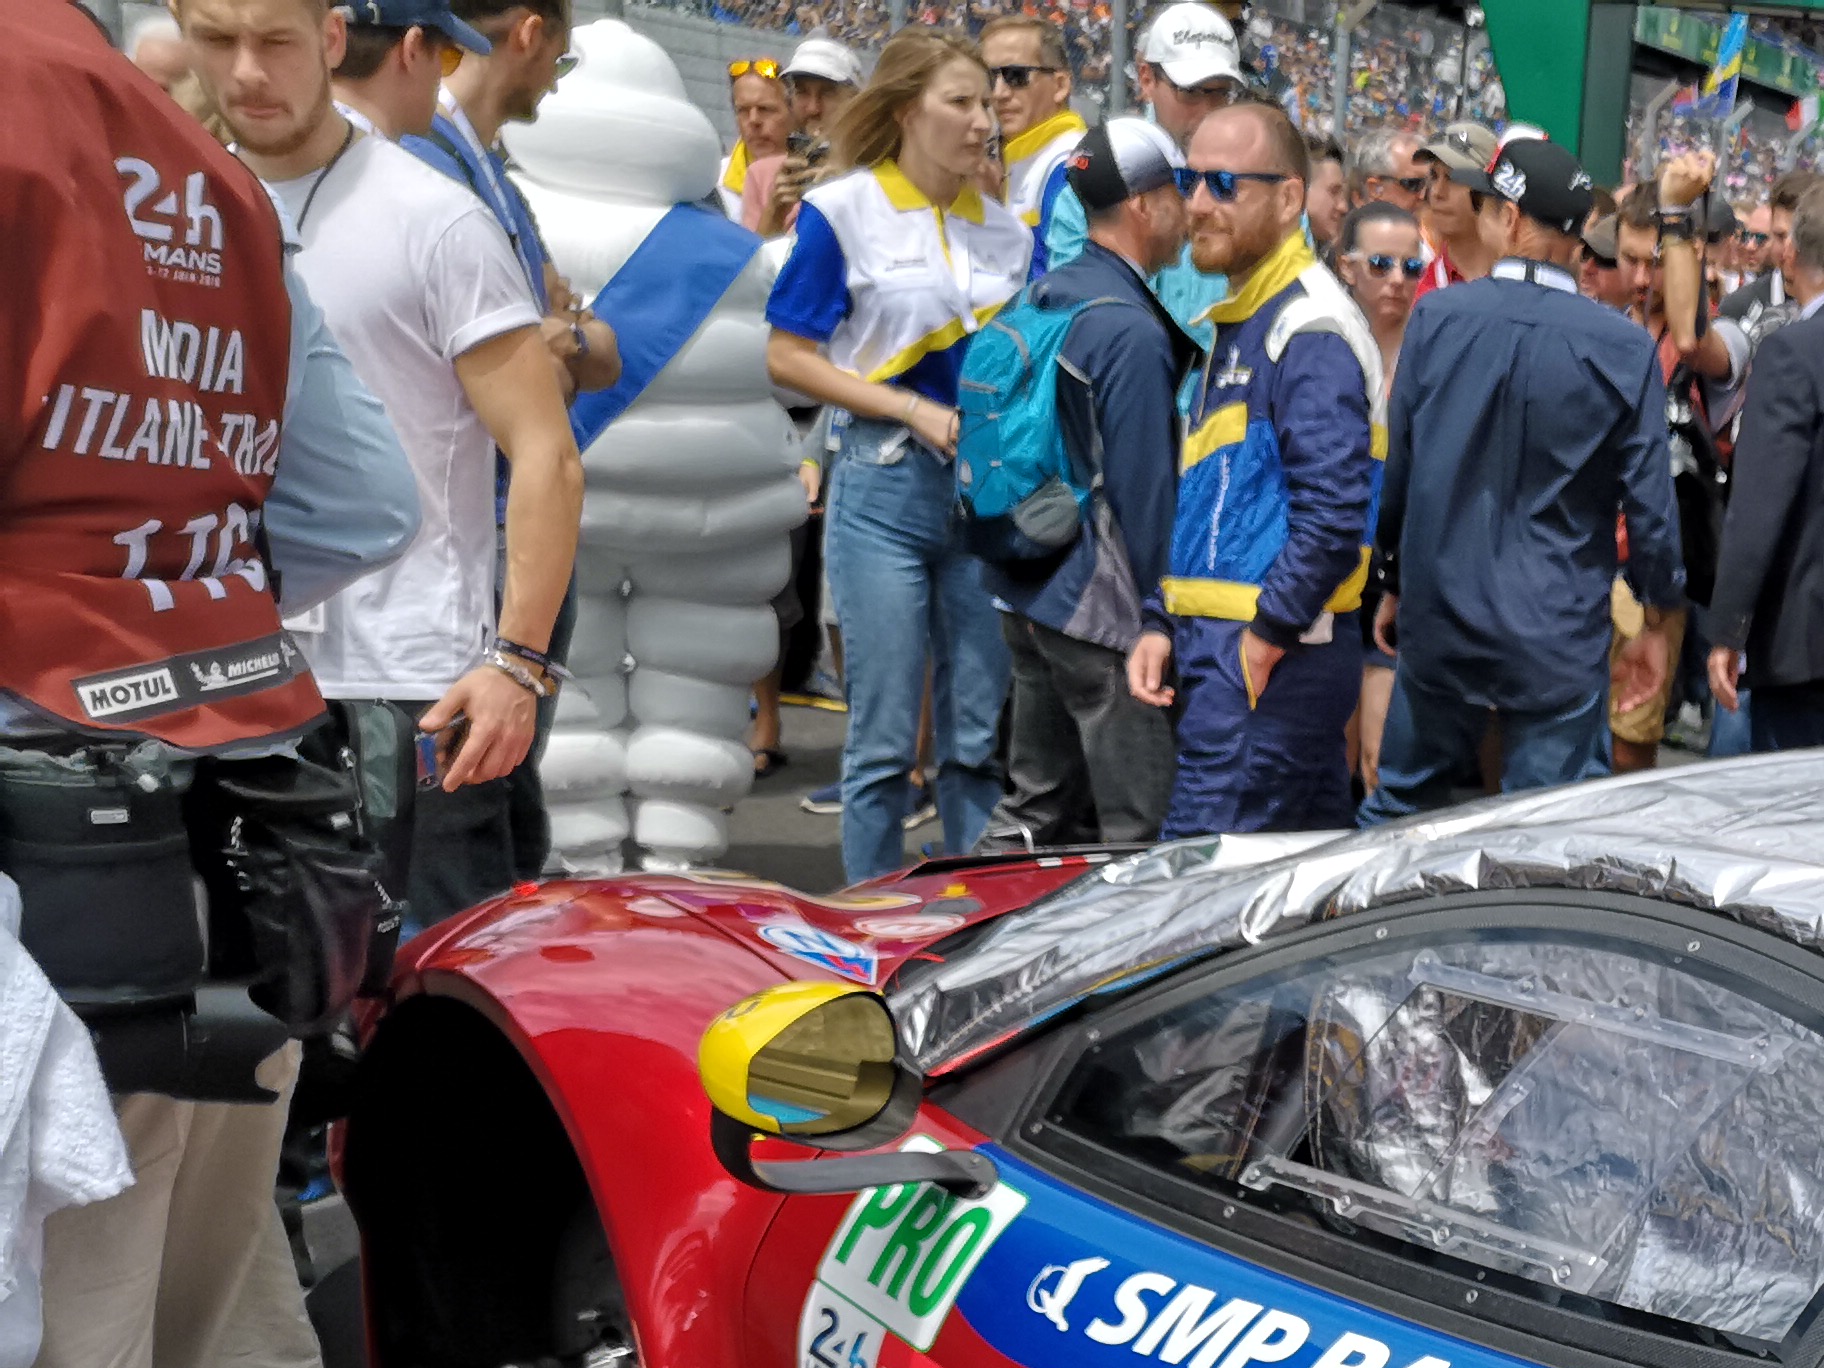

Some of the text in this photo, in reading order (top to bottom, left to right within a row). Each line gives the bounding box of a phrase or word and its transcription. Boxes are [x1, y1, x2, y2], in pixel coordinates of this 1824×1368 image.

[144, 242, 222, 275] MANS
[42, 383, 211, 470] ITLANE
[91, 675, 172, 711] MOTUL
[835, 1181, 992, 1318] PRO
